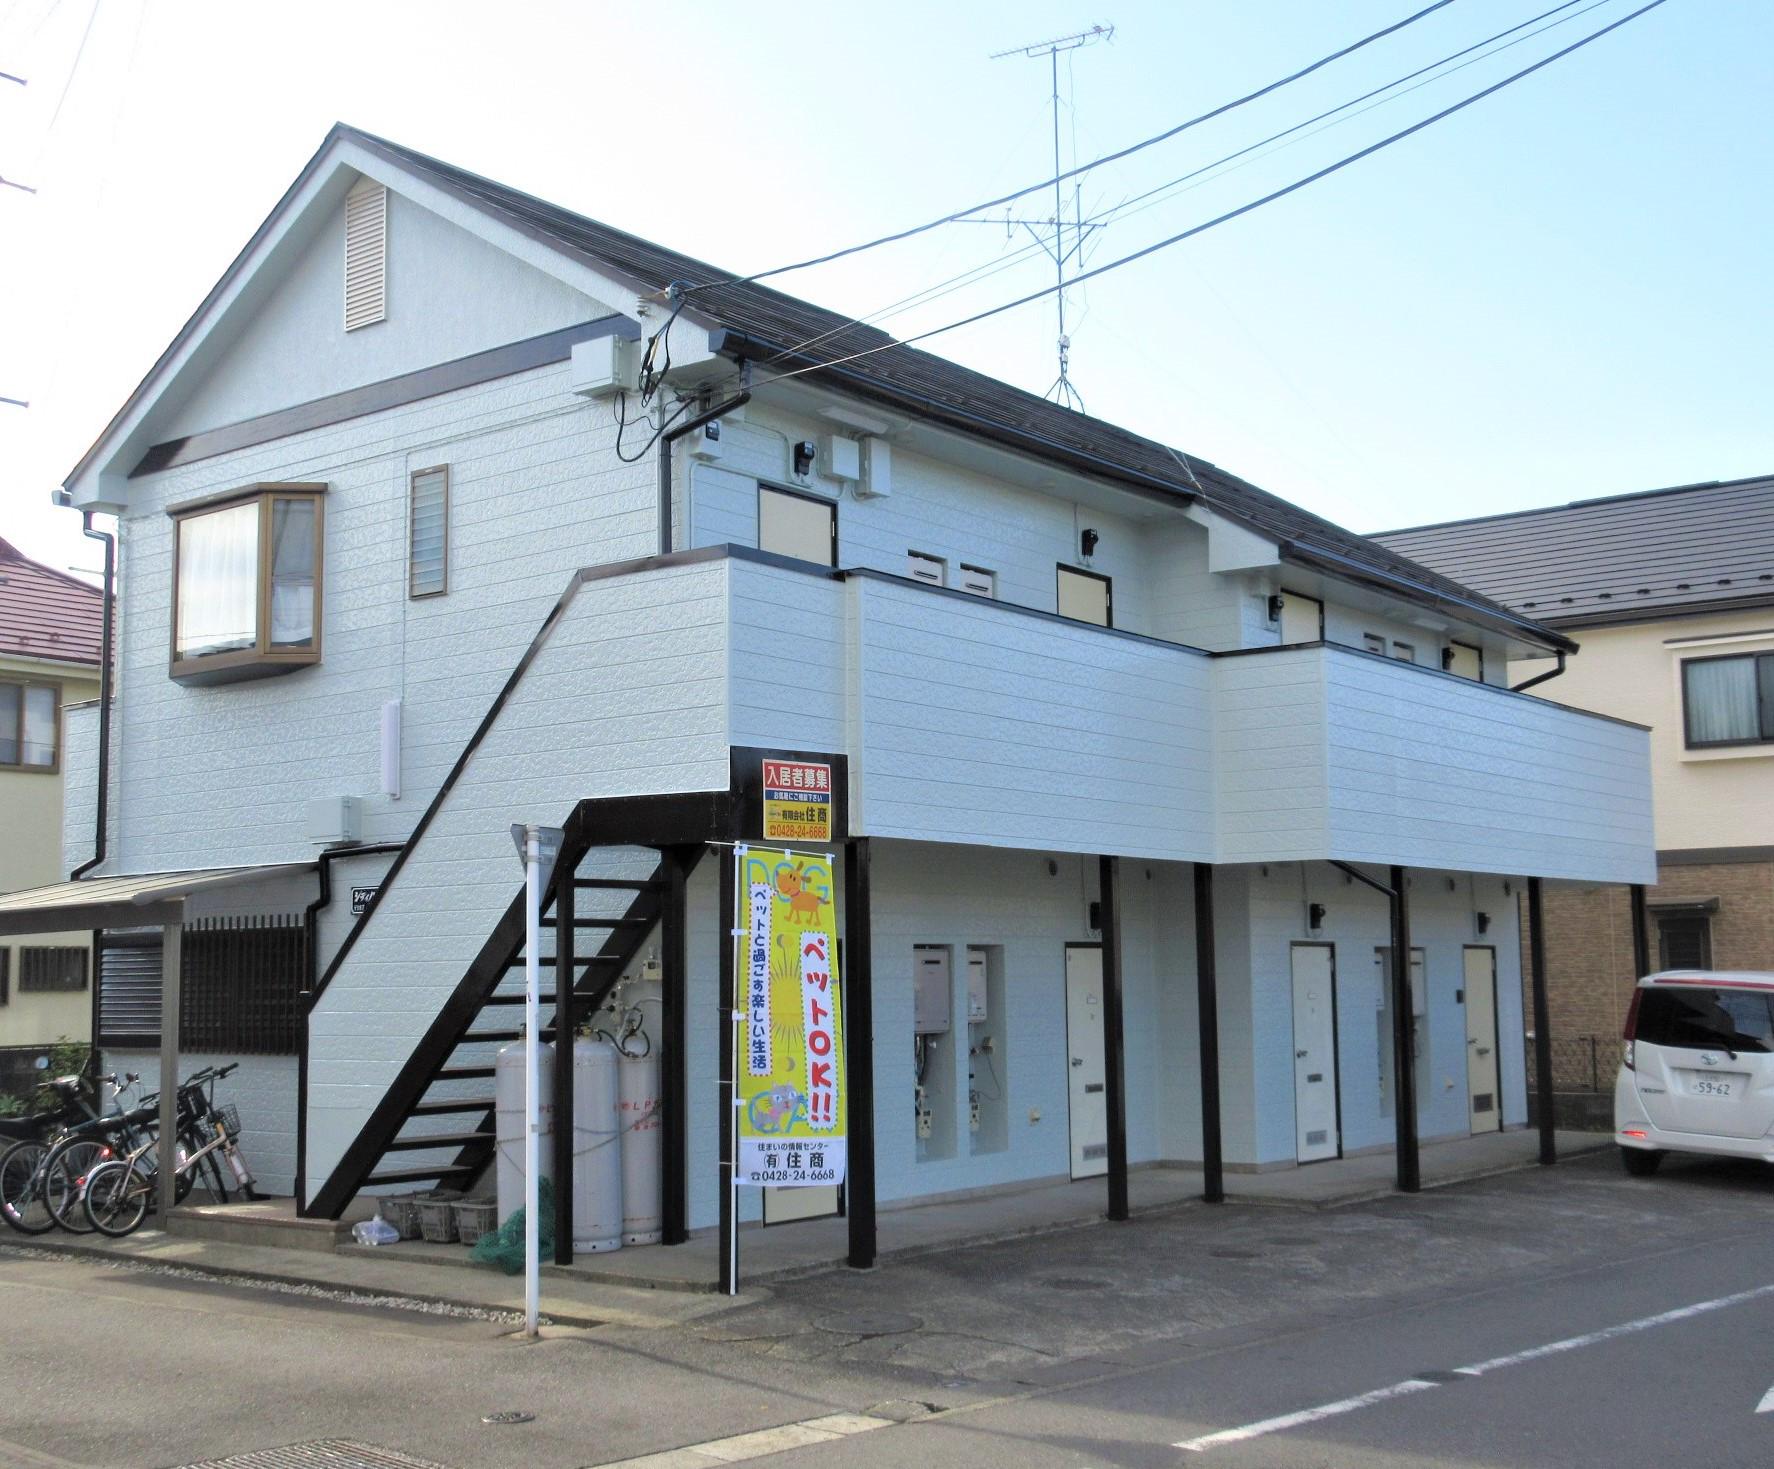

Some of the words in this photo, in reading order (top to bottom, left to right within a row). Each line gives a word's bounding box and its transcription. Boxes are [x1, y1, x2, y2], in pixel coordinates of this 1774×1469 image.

[767, 766, 828, 789] 入居者募集
[752, 889, 768, 1070] ペットと過ごす楽しい生活
[803, 937, 833, 1123] ペットOK!!
[757, 1142, 829, 1152] 住まいの情報センター
